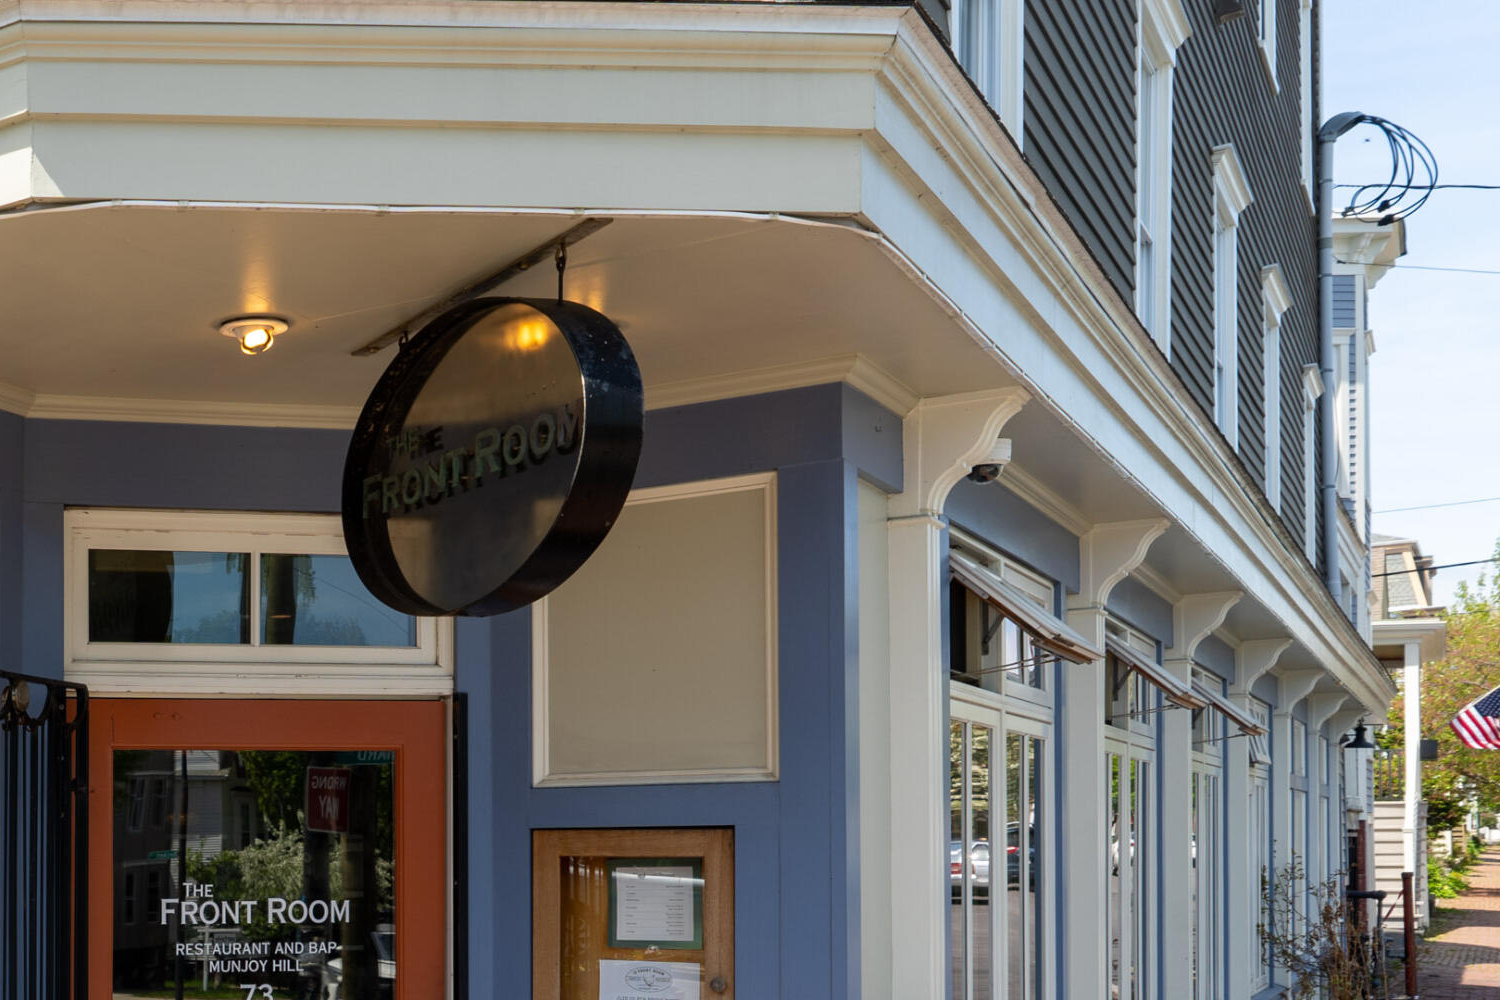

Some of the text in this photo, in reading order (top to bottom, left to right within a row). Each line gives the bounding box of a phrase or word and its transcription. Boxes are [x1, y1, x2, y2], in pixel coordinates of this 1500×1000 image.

[363, 446, 466, 519] FRONT
[183, 883, 214, 898] THE
[160, 898, 350, 925] FRONT ROOM
[176, 942, 270, 956] RESTAURANT
[274, 942, 304, 955] AND
[209, 959, 304, 974] MUNJOY HILL
